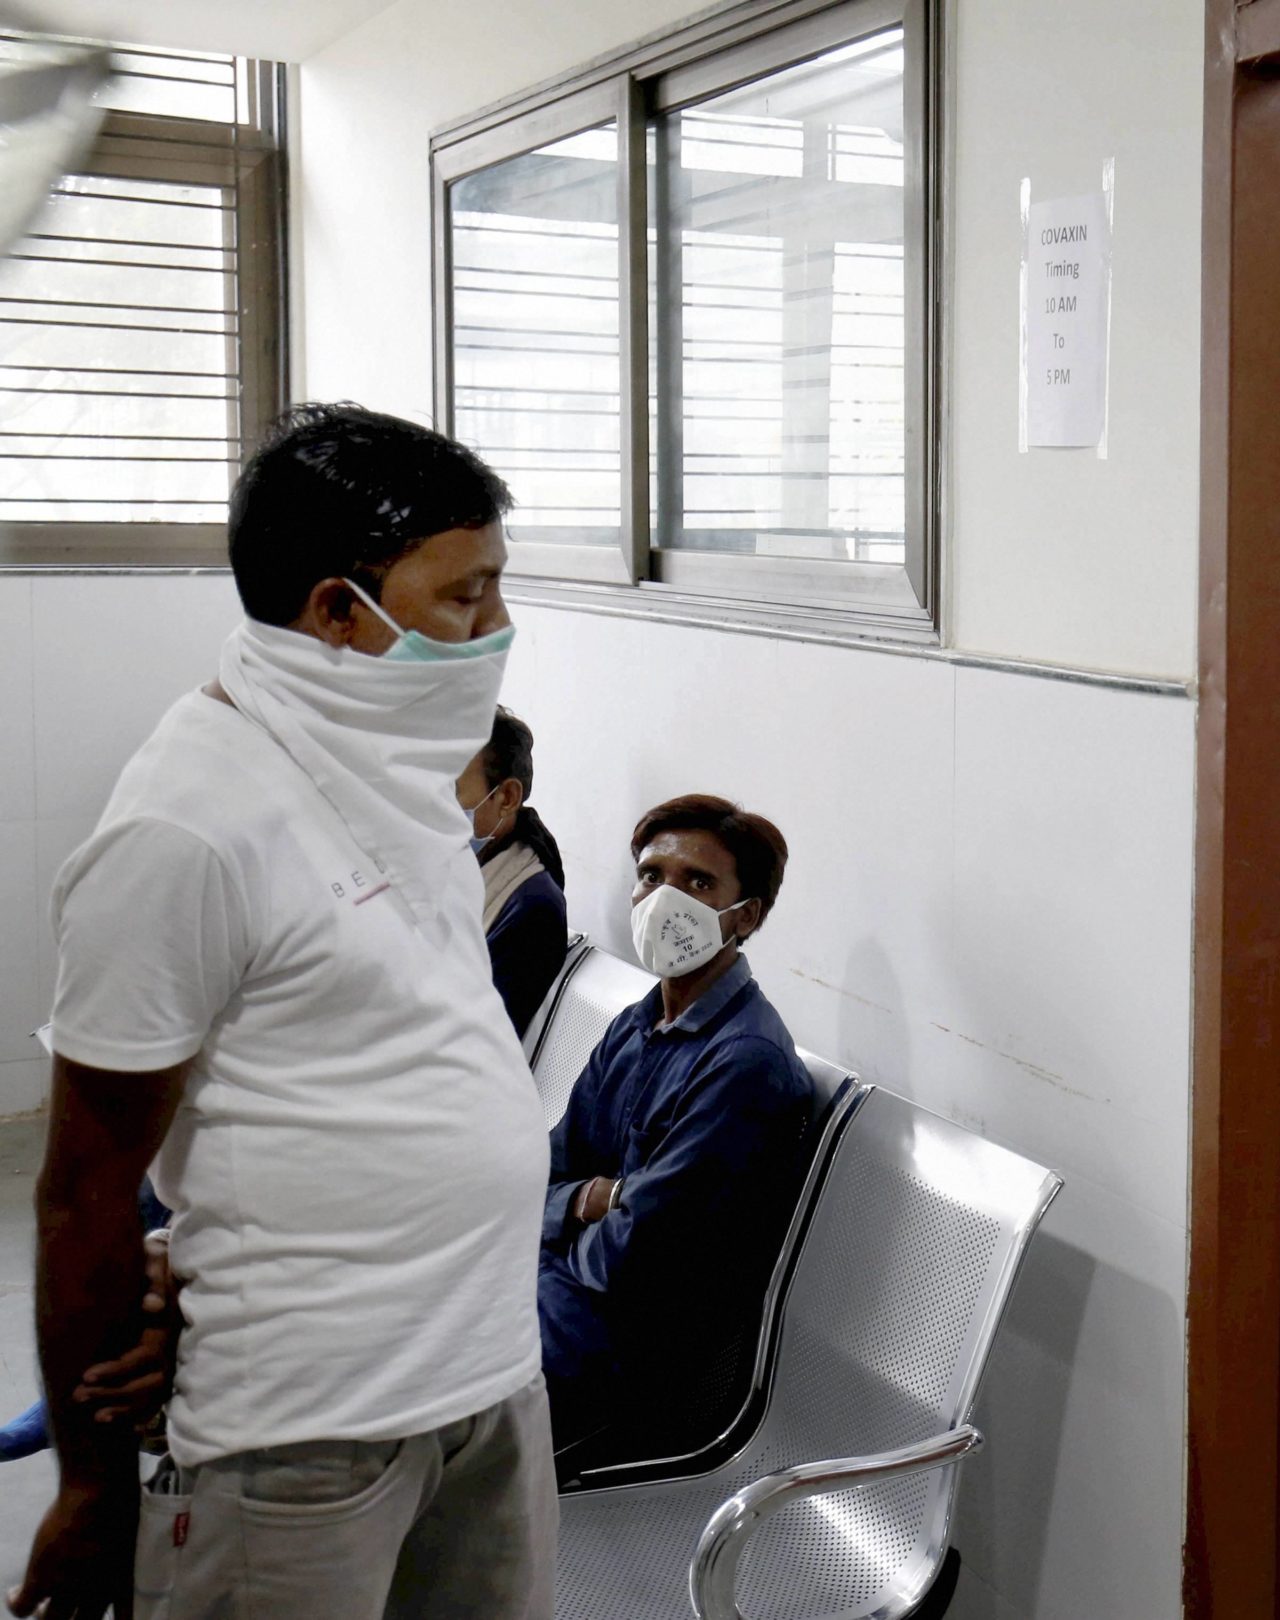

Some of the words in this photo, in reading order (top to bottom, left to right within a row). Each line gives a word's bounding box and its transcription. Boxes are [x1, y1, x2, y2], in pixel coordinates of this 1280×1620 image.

[1041, 224, 1087, 246] COVAXIN
[1045, 260, 1080, 280] Timing
[1045, 297, 1056, 313] 10
[1058, 296, 1077, 312] AM
[1053, 333, 1065, 349] To
[1046, 369, 1052, 385] 5
[1054, 368, 1071, 385] PM
[683, 943, 693, 953] 10
